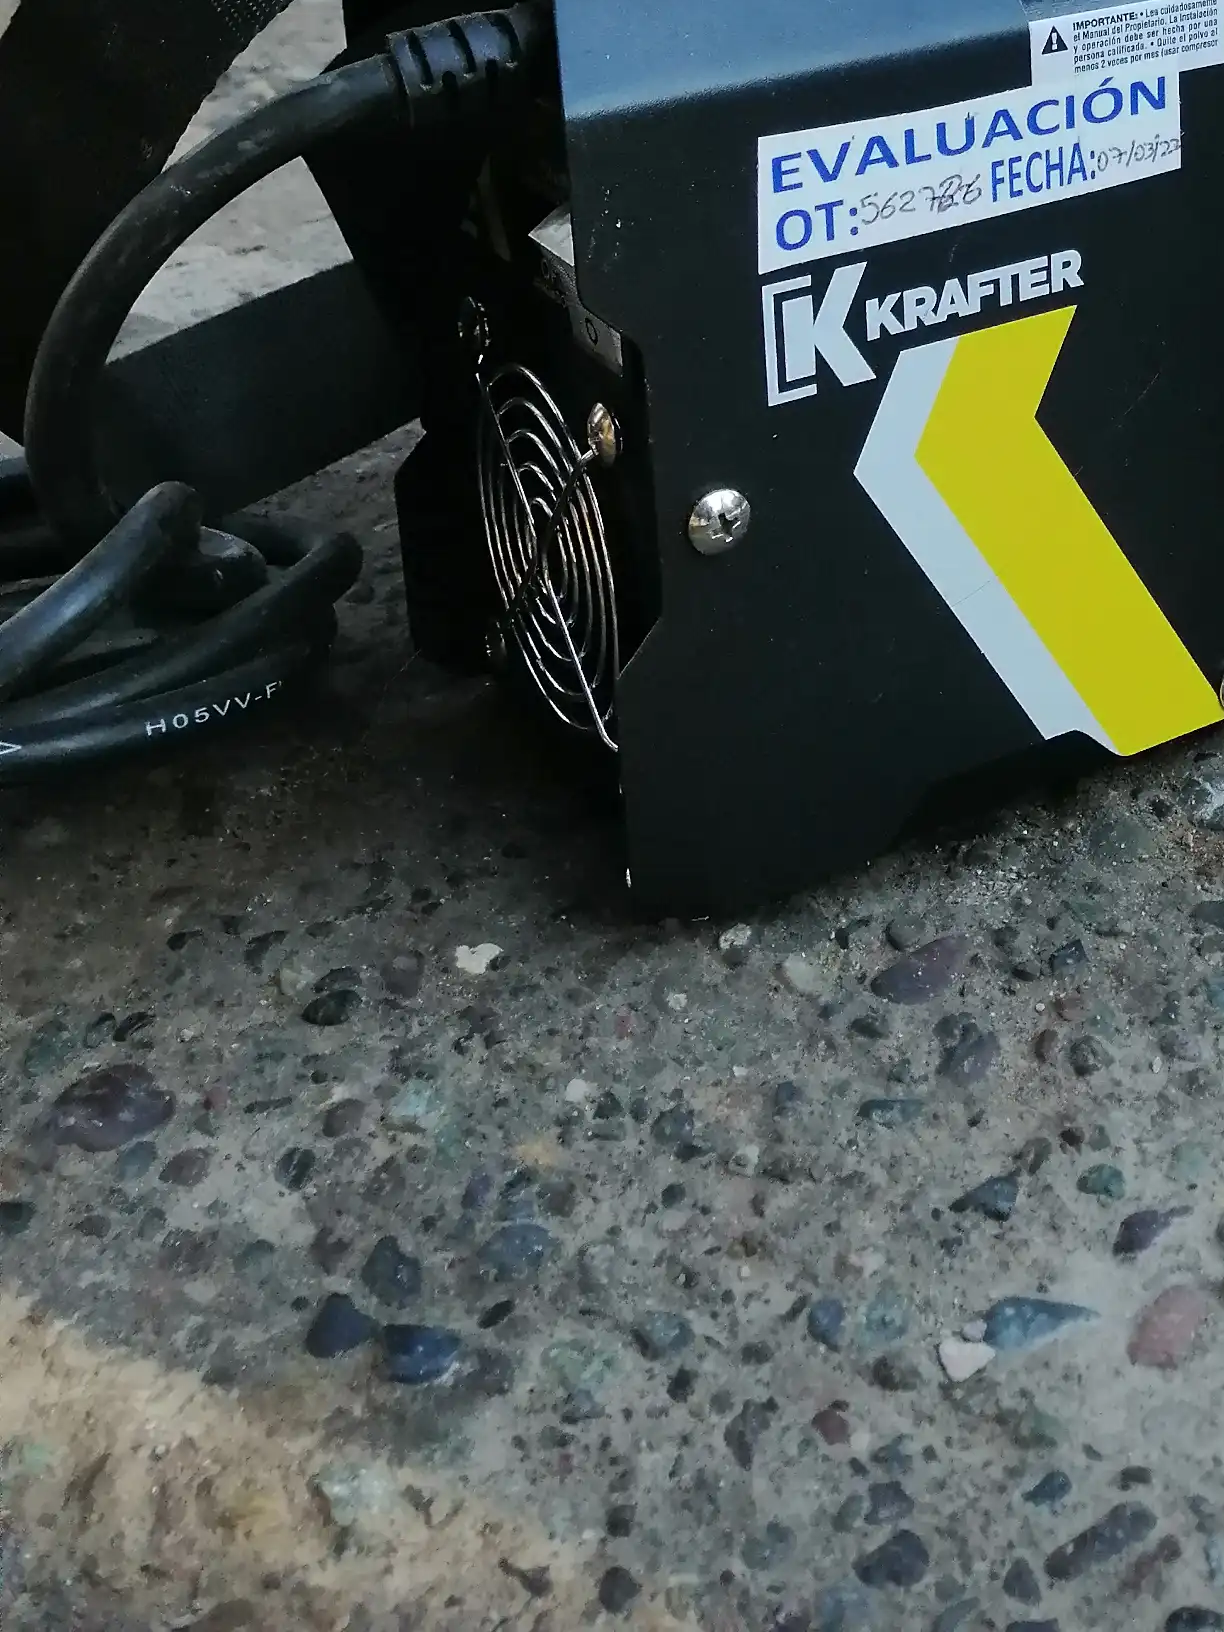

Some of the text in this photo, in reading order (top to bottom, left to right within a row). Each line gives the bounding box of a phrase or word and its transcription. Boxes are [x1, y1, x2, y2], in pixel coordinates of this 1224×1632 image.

[1073, 11, 1137, 30] IMPORTANTE:
[1145, 8, 1158, 17] Lea
[1073, 32, 1080, 41] el
[1082, 27, 1109, 39] Manual
[1111, 24, 1122, 34] del
[1125, 17, 1166, 31] Propietario.
[1169, 15, 1177, 23] La
[1073, 18, 1217, 54] y operación debe ser hecha por una
[1074, 50, 1104, 64] persona
[1157, 36, 1175, 47] Quite
[1179, 33, 1185, 42] el
[1189, 30, 1207, 42] polvo
[1211, 27, 1217, 36] al
[1074, 39, 1217, 73] menos 2 veces por mes (usar compresor
[772, 76, 1167, 193] EVALUACIÓN
[991, 142, 1096, 202] FECHA:
[775, 197, 860, 252] OT:
[865, 249, 1085, 342] KRAFTER
[145, 680, 279, 737] H05VV-F
